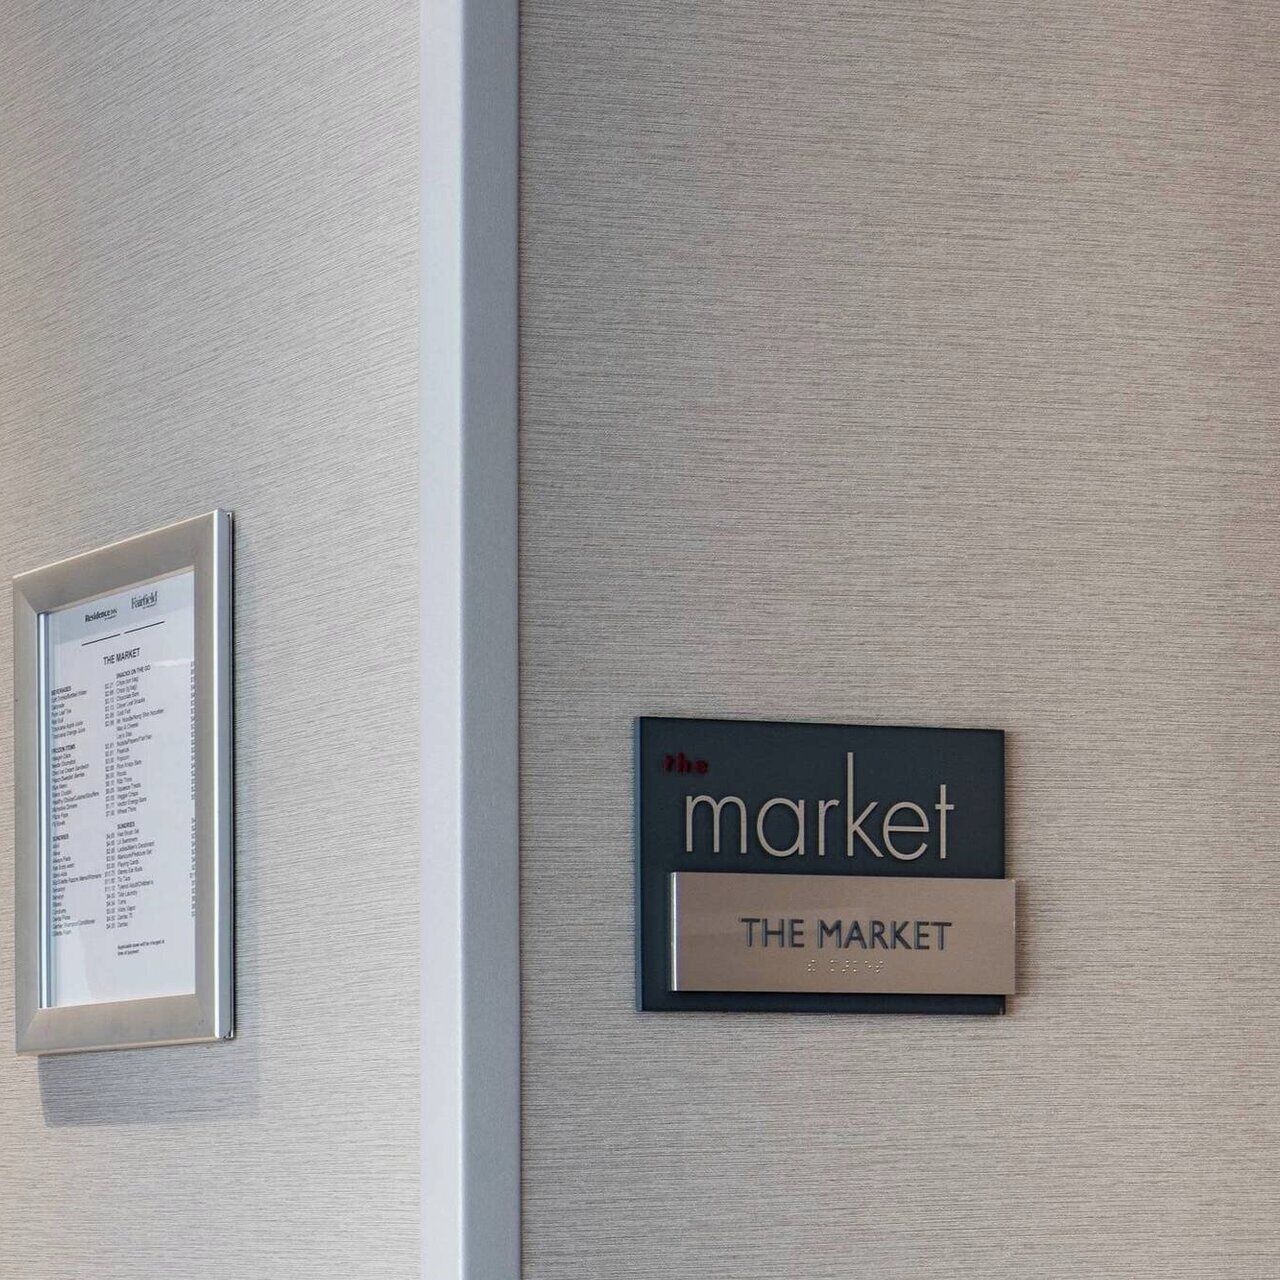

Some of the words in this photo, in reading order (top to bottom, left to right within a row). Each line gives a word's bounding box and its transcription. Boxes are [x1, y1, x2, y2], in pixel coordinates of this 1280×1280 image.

[116, 647, 140, 662] MARKET
[662, 752, 708, 775] the
[685, 752, 955, 860] market
[741, 917, 805, 948] THE
[817, 919, 952, 950] MARKET
